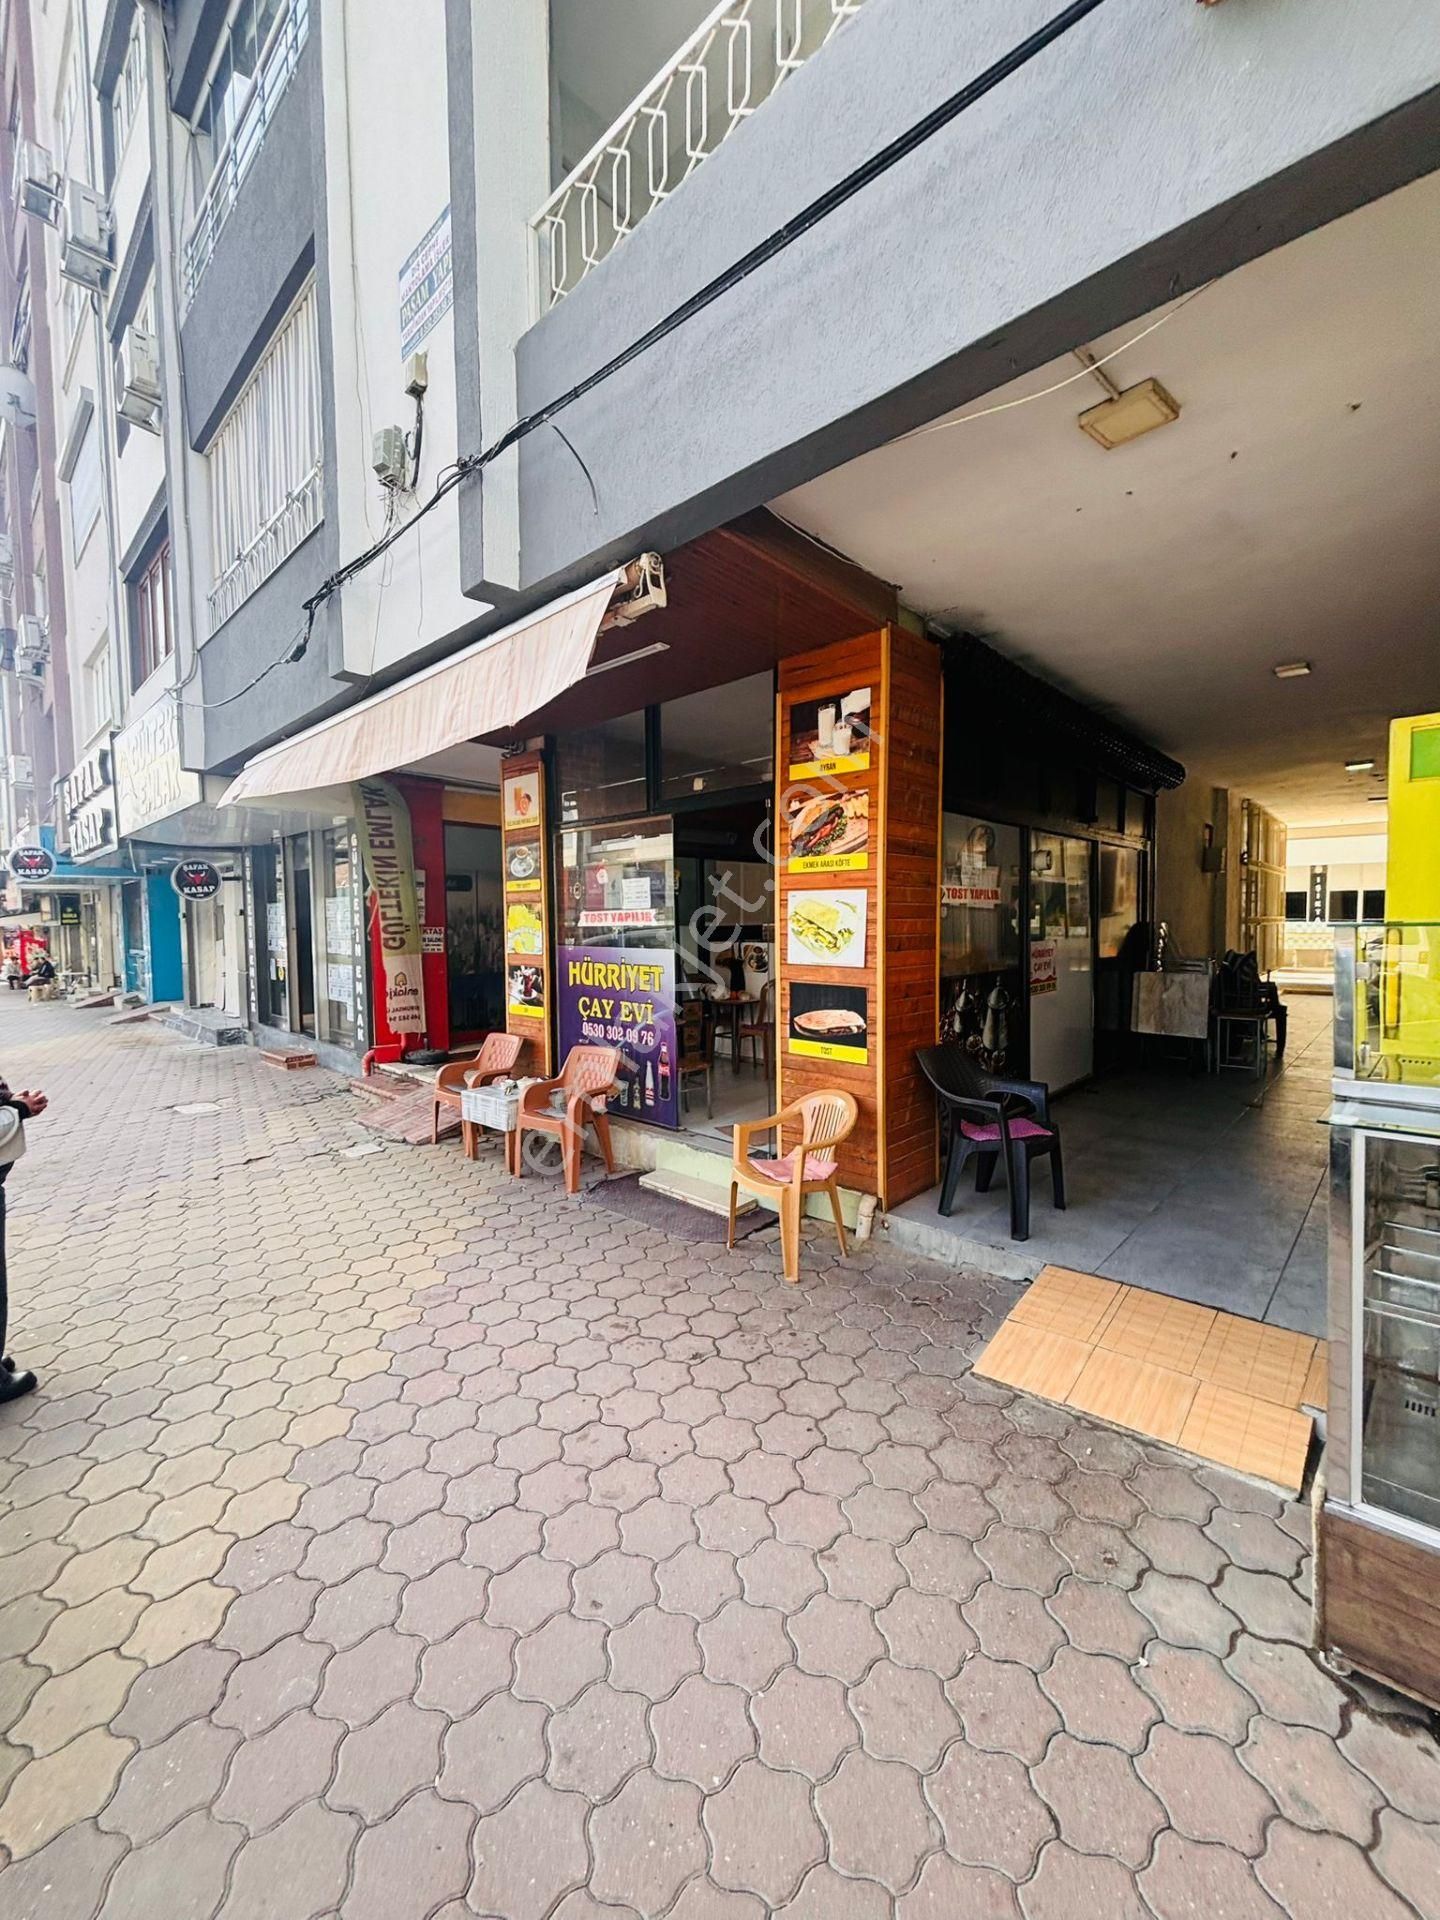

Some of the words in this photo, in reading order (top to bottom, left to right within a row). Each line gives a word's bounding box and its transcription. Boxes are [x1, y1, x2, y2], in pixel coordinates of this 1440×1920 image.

[433, 250, 452, 289] YAPI
[69, 809, 107, 857] KASAP
[802, 861, 819, 869] EKMEK
[820, 860, 834, 868] ARASI
[835, 858, 851, 867] KÖFTE
[183, 886, 215, 894] KASAP
[351, 833, 362, 957] GÜLTEKİN
[946, 887, 969, 899] TOST
[970, 887, 999, 900] YAPILIR
[584, 913, 610, 923] TOST
[611, 911, 653, 923] YAPILIR
[568, 955, 664, 993] HÜRRİYET
[355, 965, 364, 1042] EMLAK
[578, 997, 614, 1021] ÇAY
[620, 1000, 654, 1025] EVİ
[582, 1022, 604, 1037] 0530
[606, 1025, 624, 1041] 302
[626, 1028, 639, 1044] 09
[640, 1031, 655, 1047] 76
[820, 1046, 833, 1056] TOST
